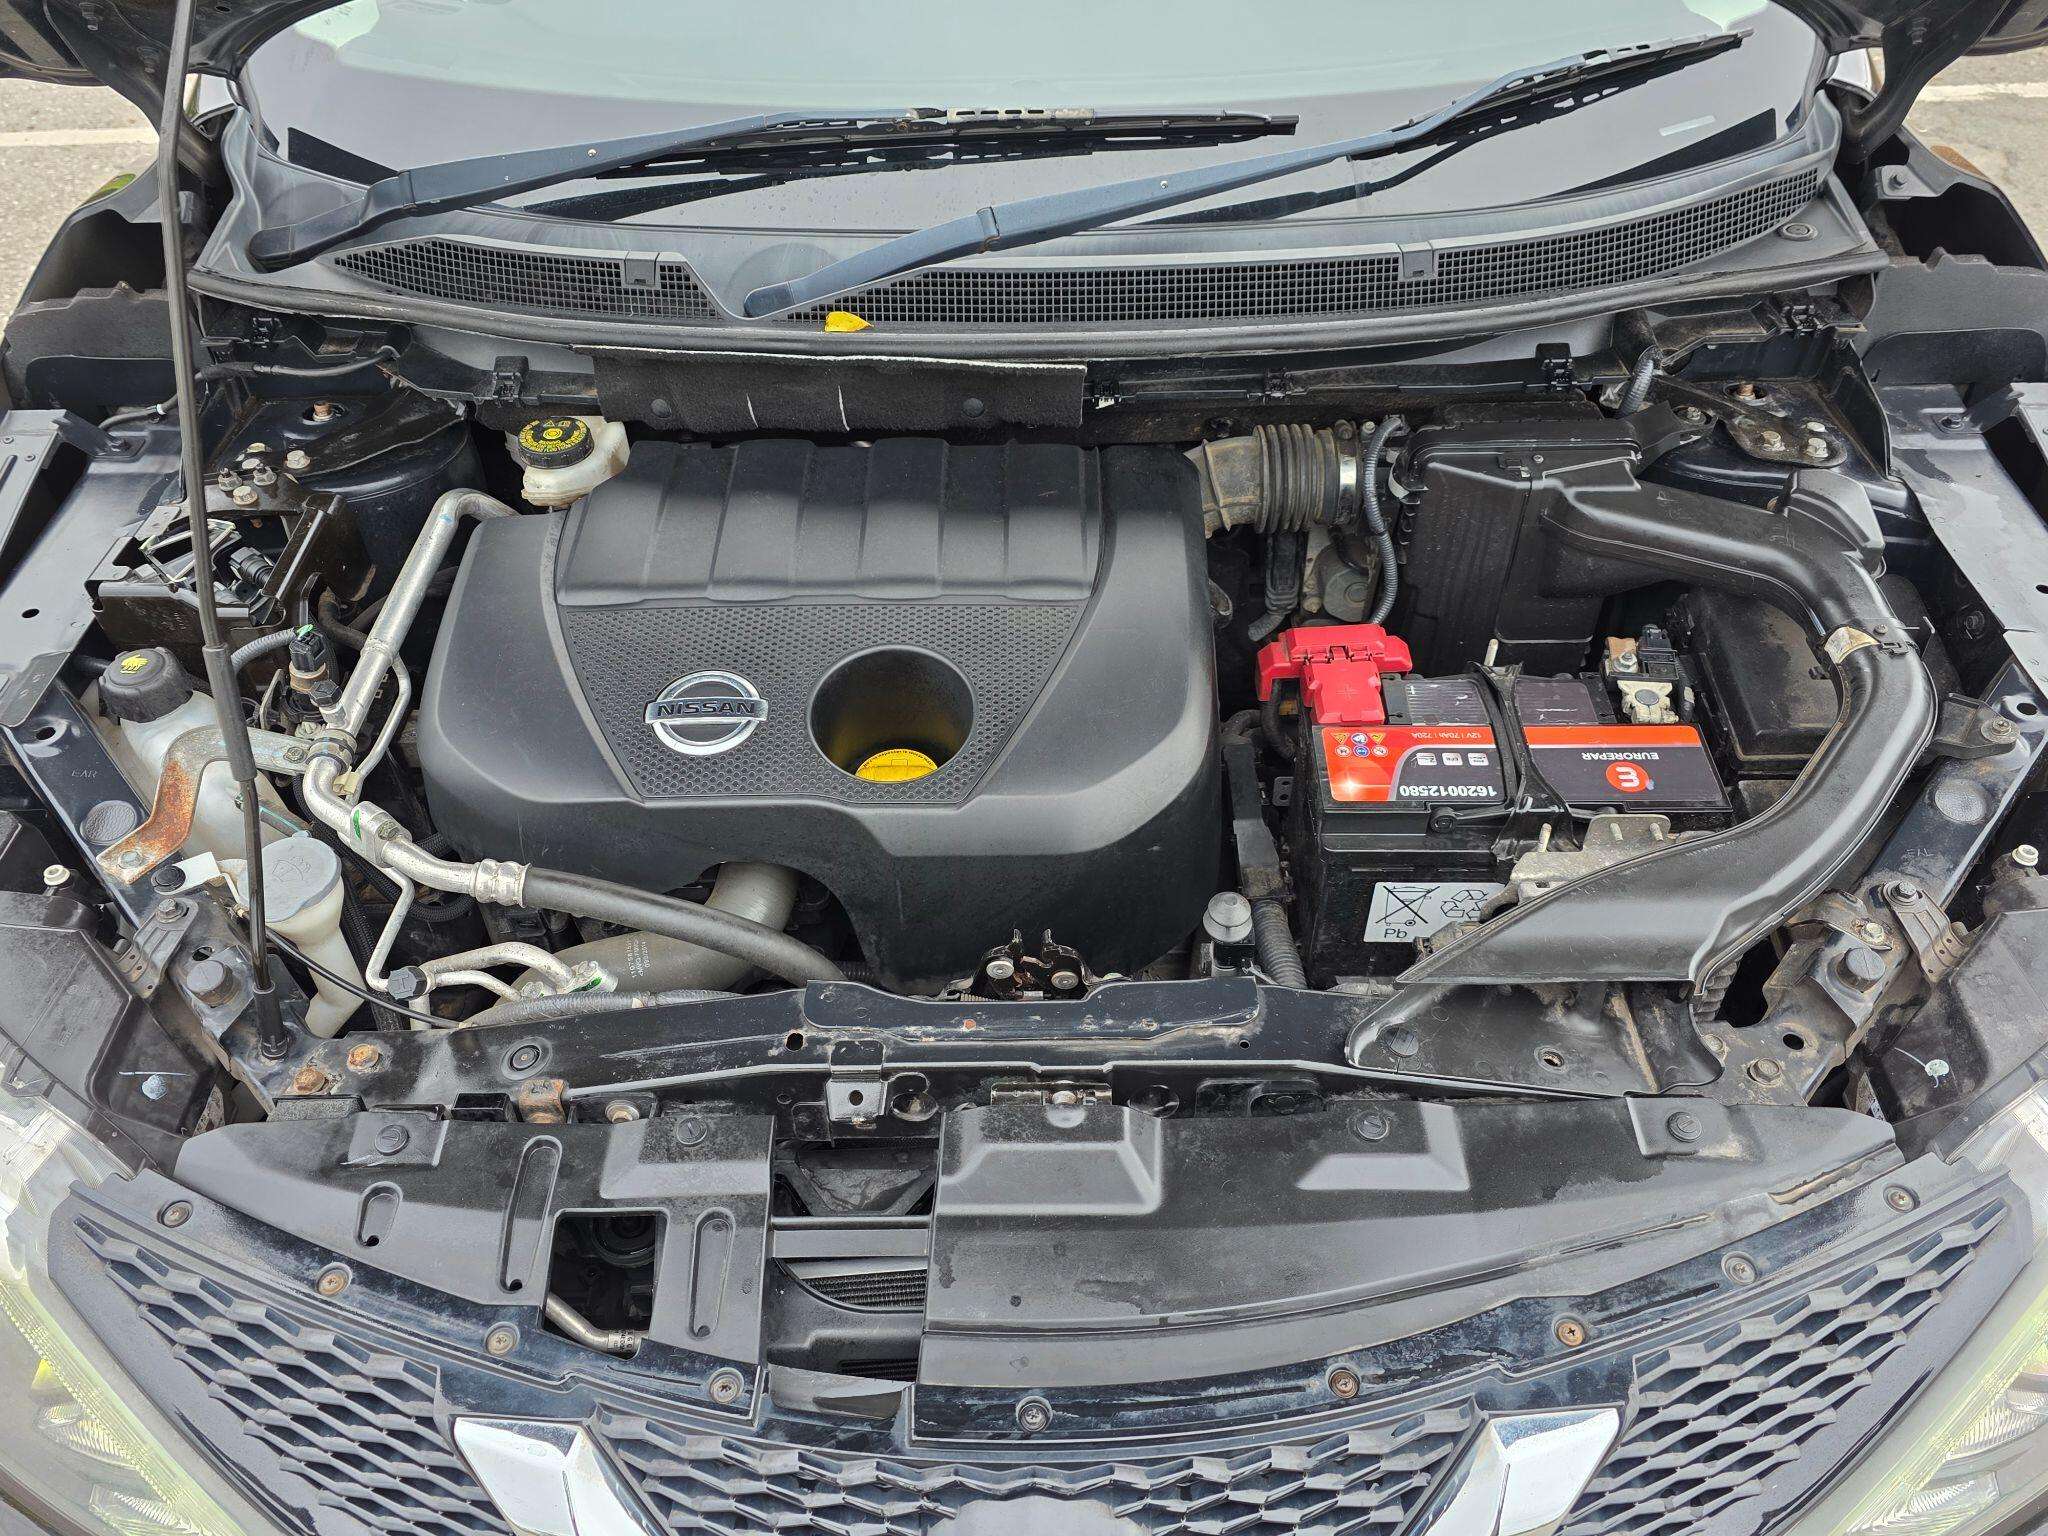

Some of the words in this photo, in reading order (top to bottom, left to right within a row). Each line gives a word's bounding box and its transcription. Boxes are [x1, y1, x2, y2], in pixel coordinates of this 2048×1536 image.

[657, 701, 755, 717] NISSAN
[1581, 751, 1660, 761] EUROREPAR
[1400, 785, 1498, 797] 1620012580
[1384, 928, 1408, 939] Pb
